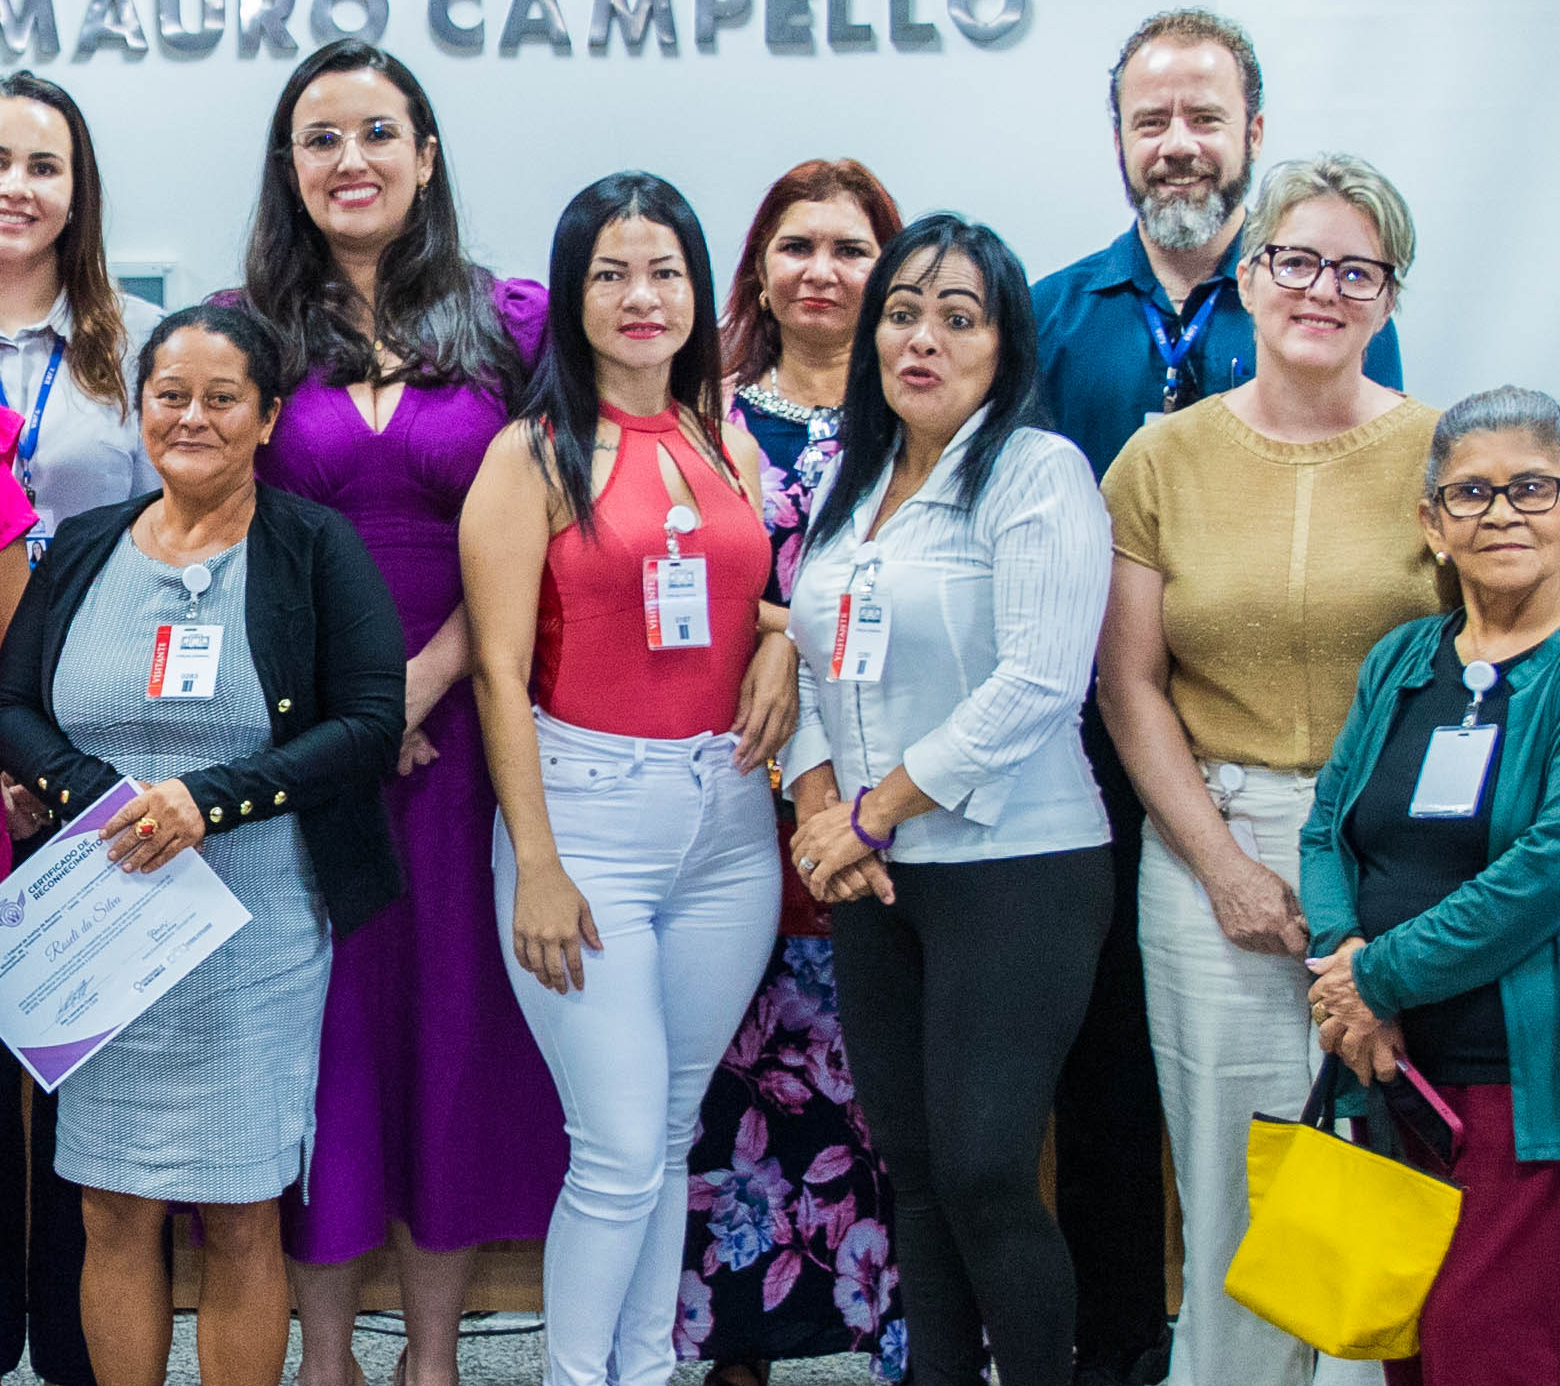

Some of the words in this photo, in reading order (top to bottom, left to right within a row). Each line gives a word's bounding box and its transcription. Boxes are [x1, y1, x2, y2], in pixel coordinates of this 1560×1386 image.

[28, 849, 78, 894] CERTIFICADO
[77, 838, 90, 852] DE
[32, 838, 103, 901] RECONHECIMENTO
